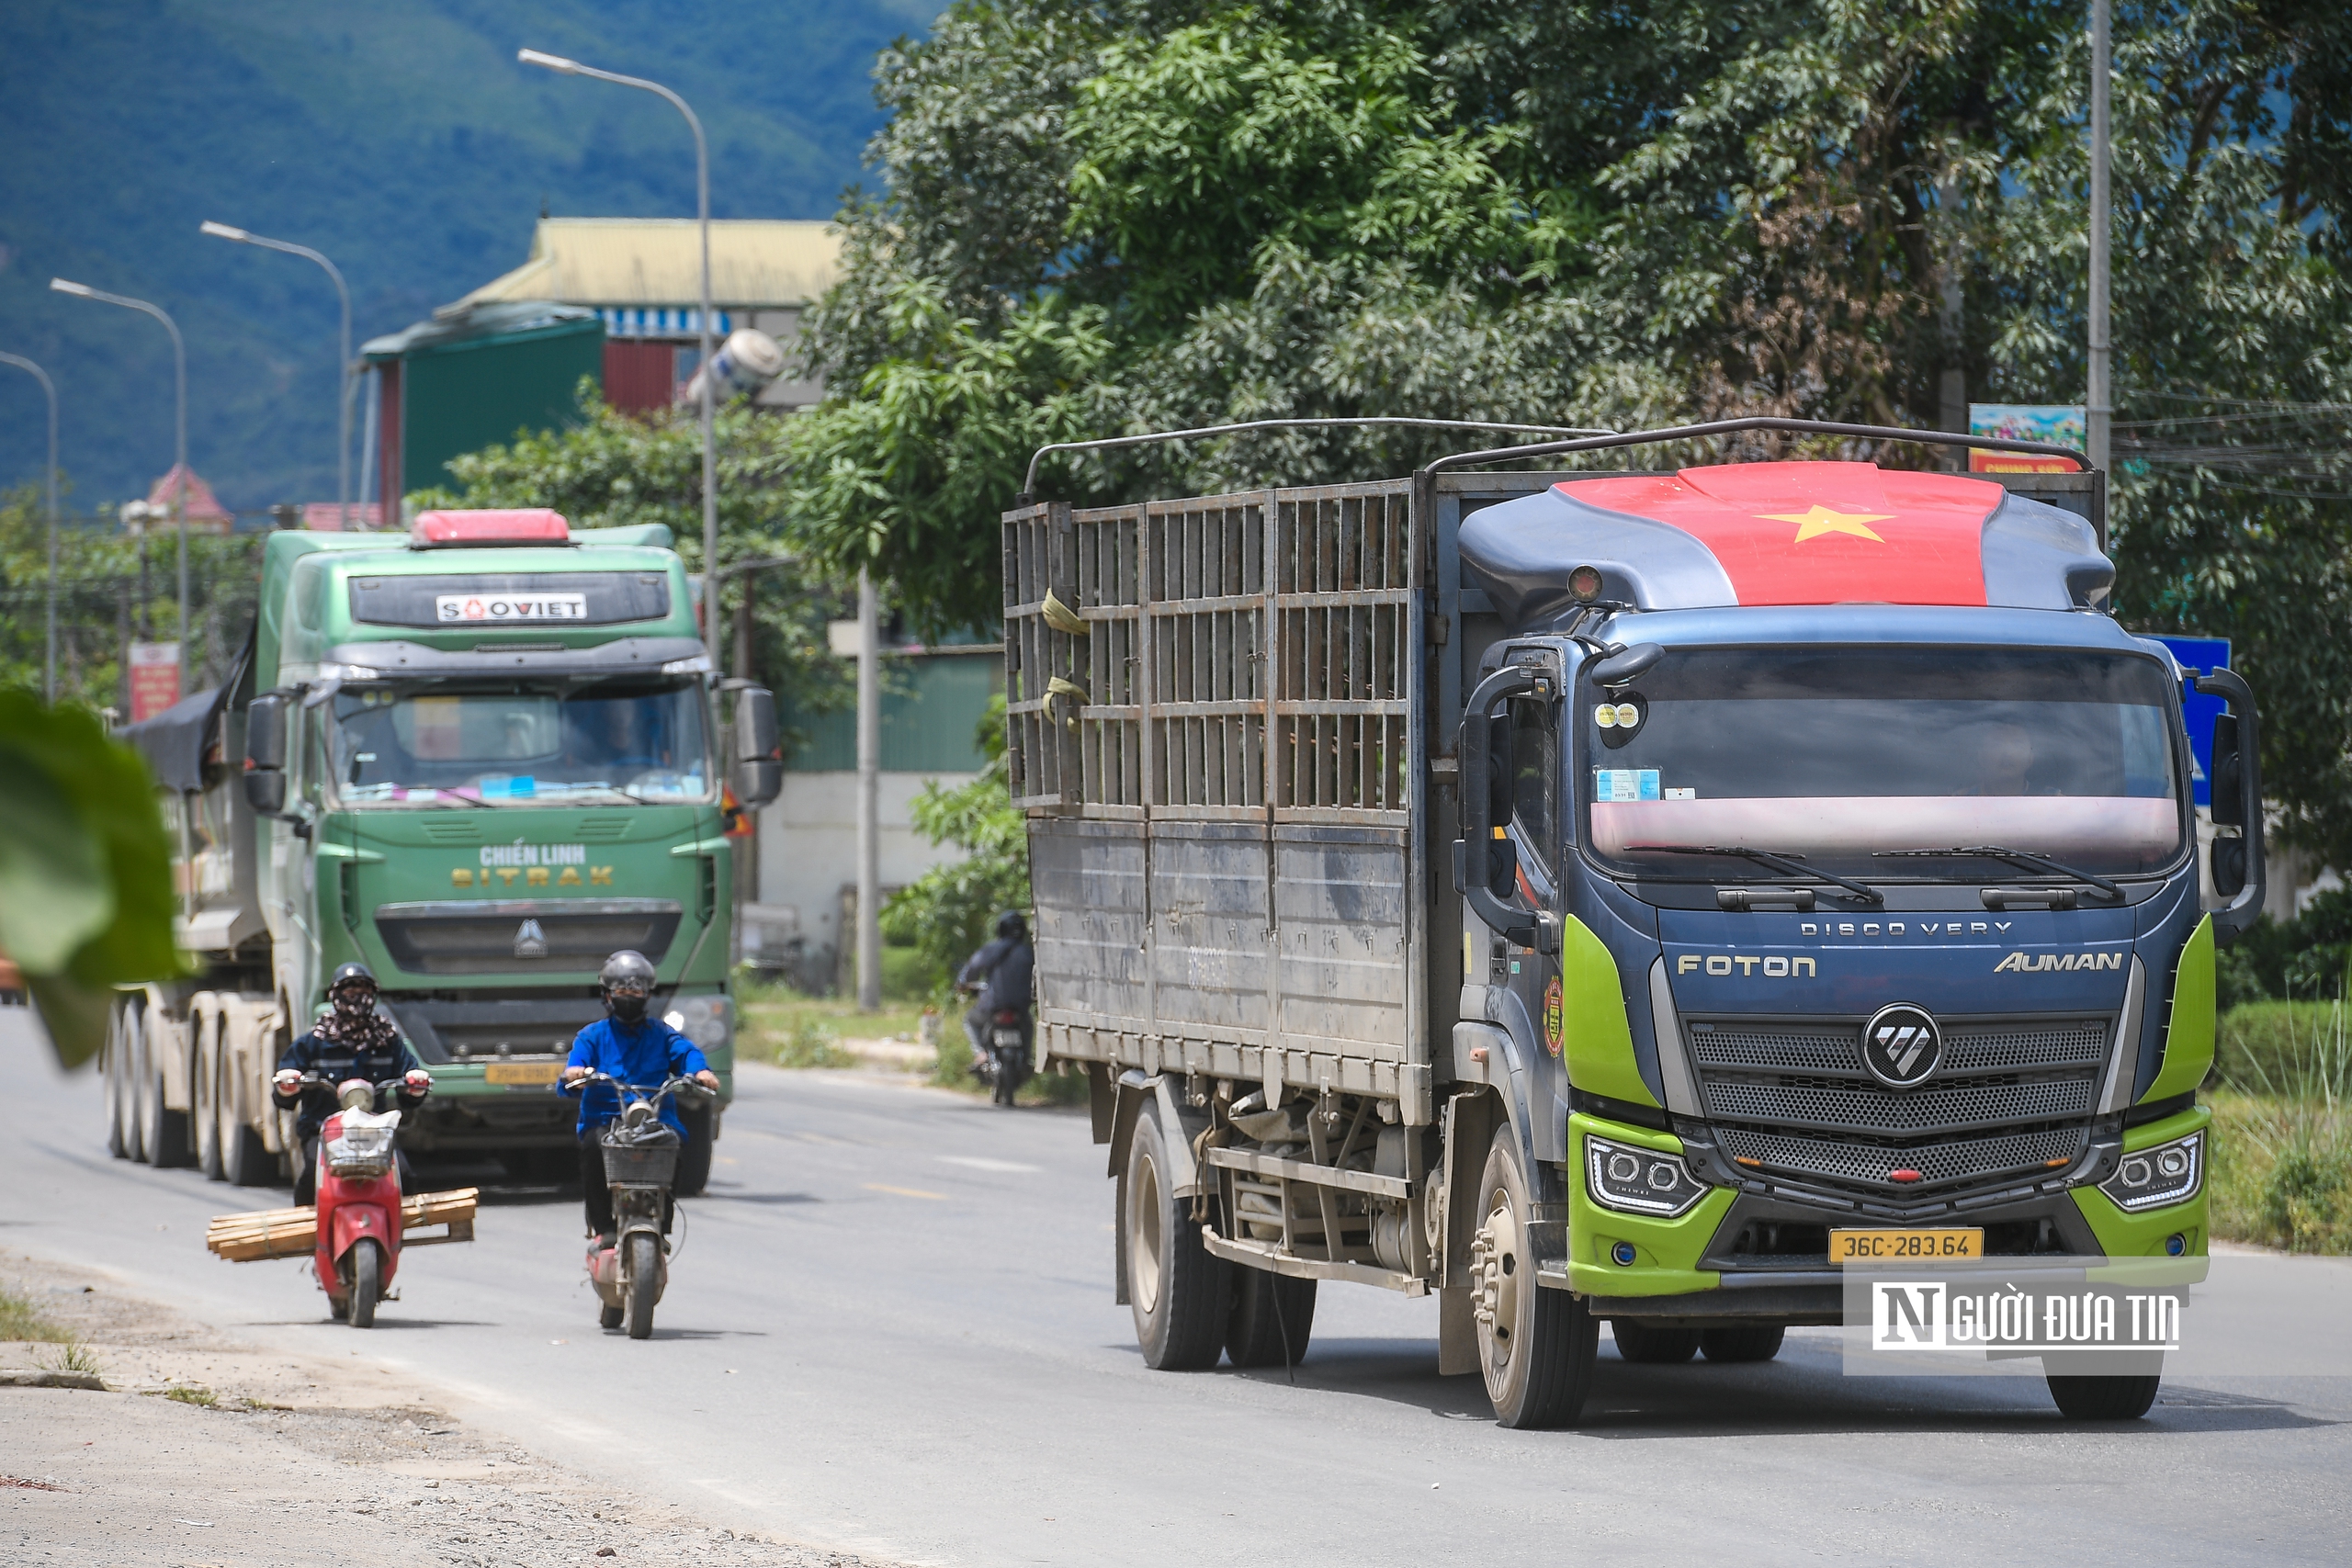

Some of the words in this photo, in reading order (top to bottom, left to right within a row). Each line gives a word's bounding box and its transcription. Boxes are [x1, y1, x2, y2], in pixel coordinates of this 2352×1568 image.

[480, 837, 538, 866] CHIẾN
[541, 843, 586, 865] LINH
[451, 865, 613, 888] SITRAK
[1678, 955, 1816, 977] FOTON
[1994, 952, 2122, 973] AUMAN
[1844, 1235, 1969, 1257] 36C-283.64
